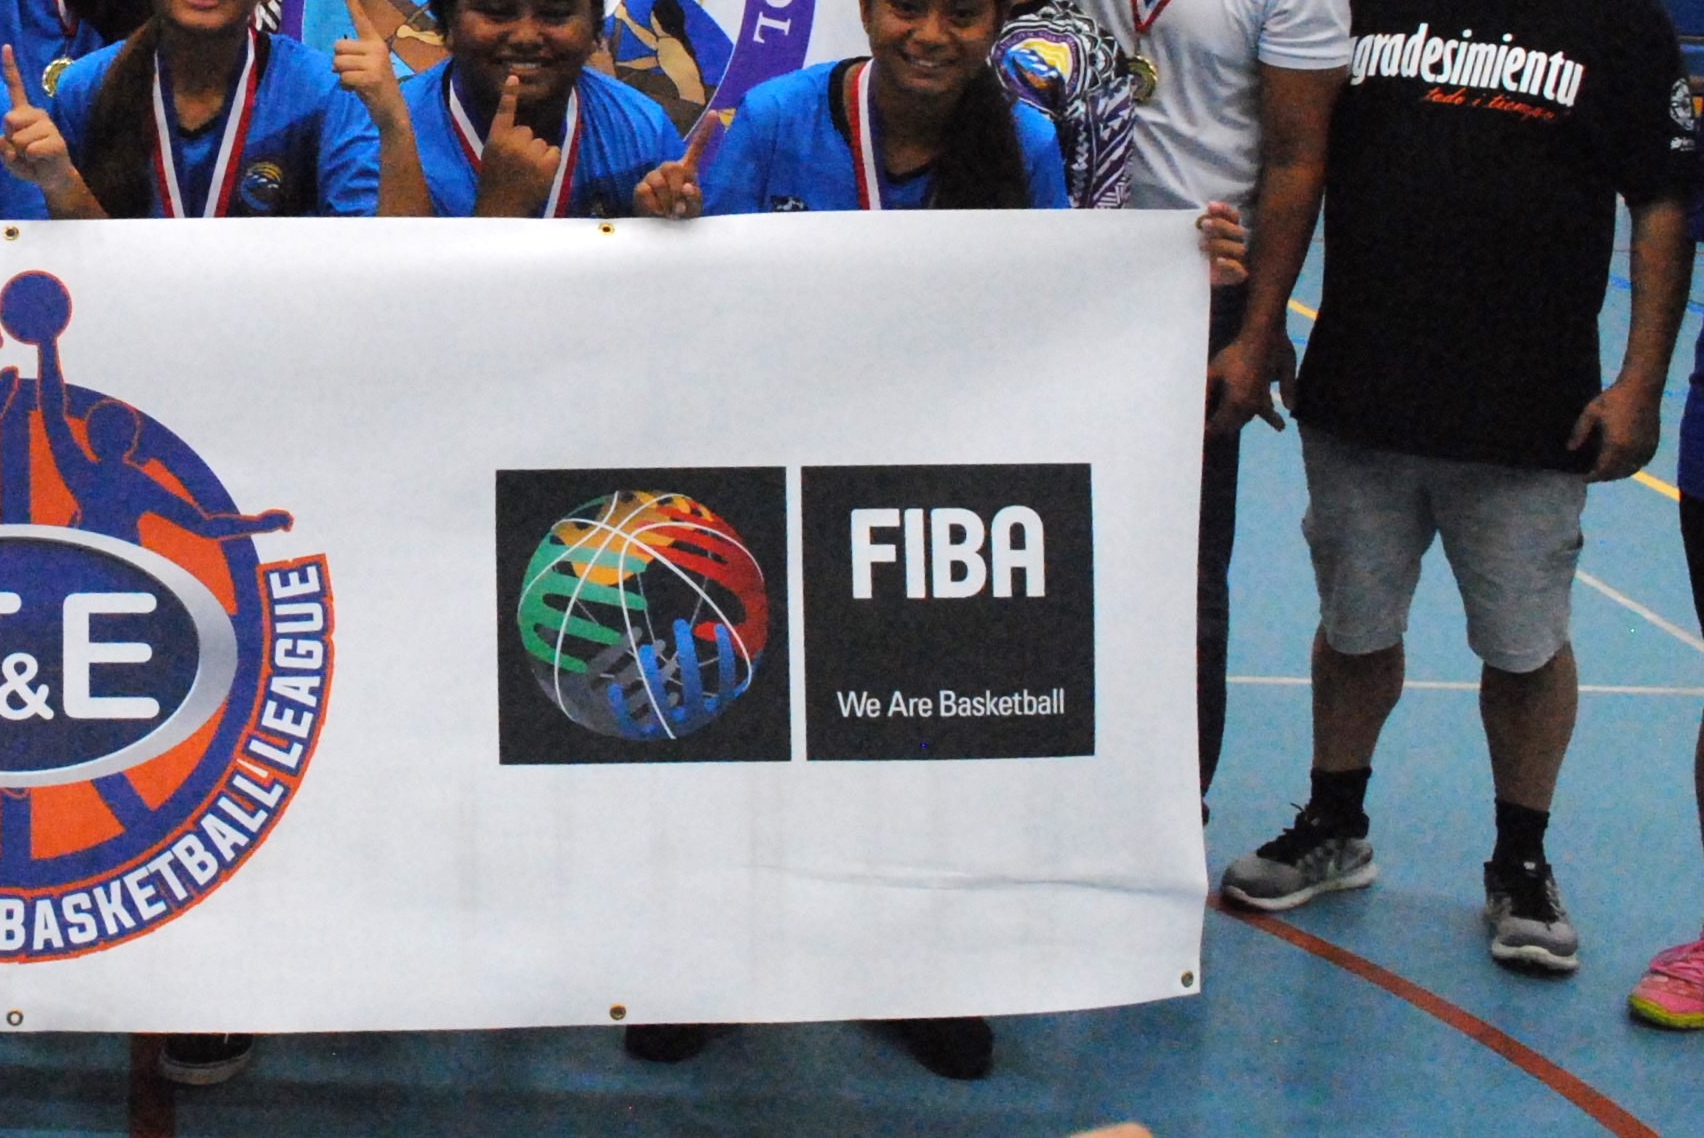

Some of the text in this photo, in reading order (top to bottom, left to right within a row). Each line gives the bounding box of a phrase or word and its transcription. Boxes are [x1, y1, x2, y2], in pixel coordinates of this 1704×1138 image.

[850, 505, 1046, 599] FIBA
[249, 565, 324, 769] LEAGUE
[836, 688, 1065, 718] We Are Basketball
